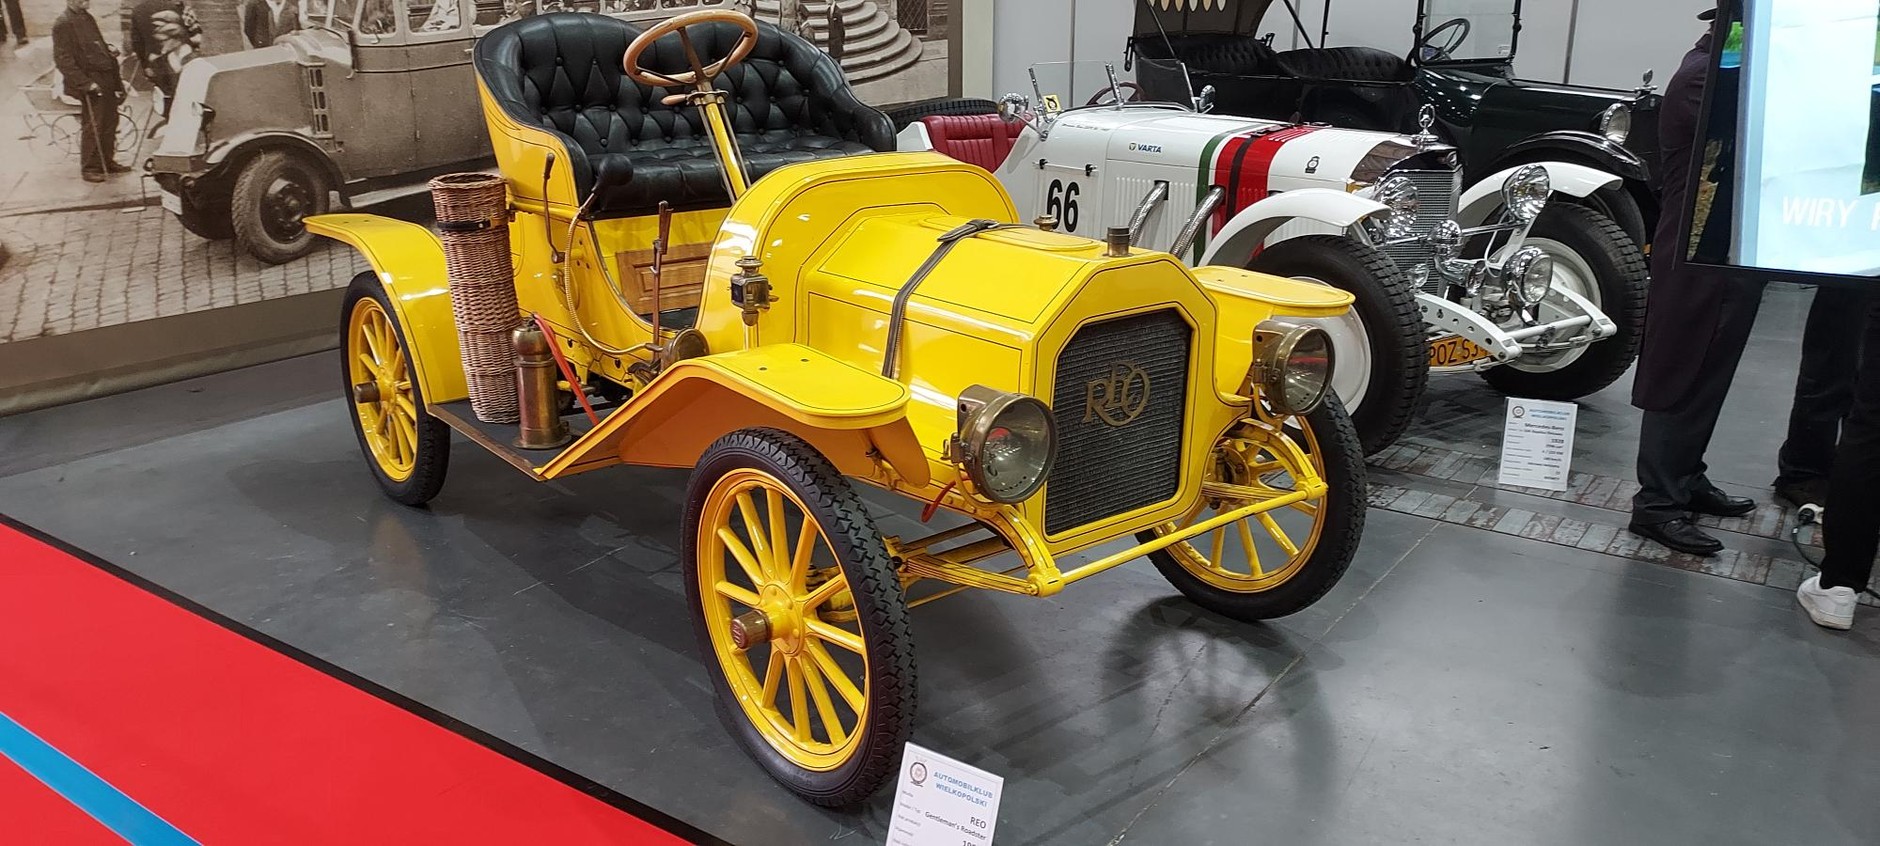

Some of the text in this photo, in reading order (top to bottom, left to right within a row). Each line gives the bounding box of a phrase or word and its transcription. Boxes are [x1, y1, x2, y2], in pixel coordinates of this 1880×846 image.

[1138, 144, 1162, 153] VARTA
[1046, 178, 1080, 233] 66
[1781, 196, 1858, 229] WIRY
[1082, 361, 1151, 427] REO
[933, 771, 993, 799] AUTOMOBILKLUB
[935, 782, 988, 807] WIELKOPOLSKI
[924, 811, 960, 830] Gentleman's
[960, 825, 987, 840] Roadster
[969, 816, 987, 829] REO
